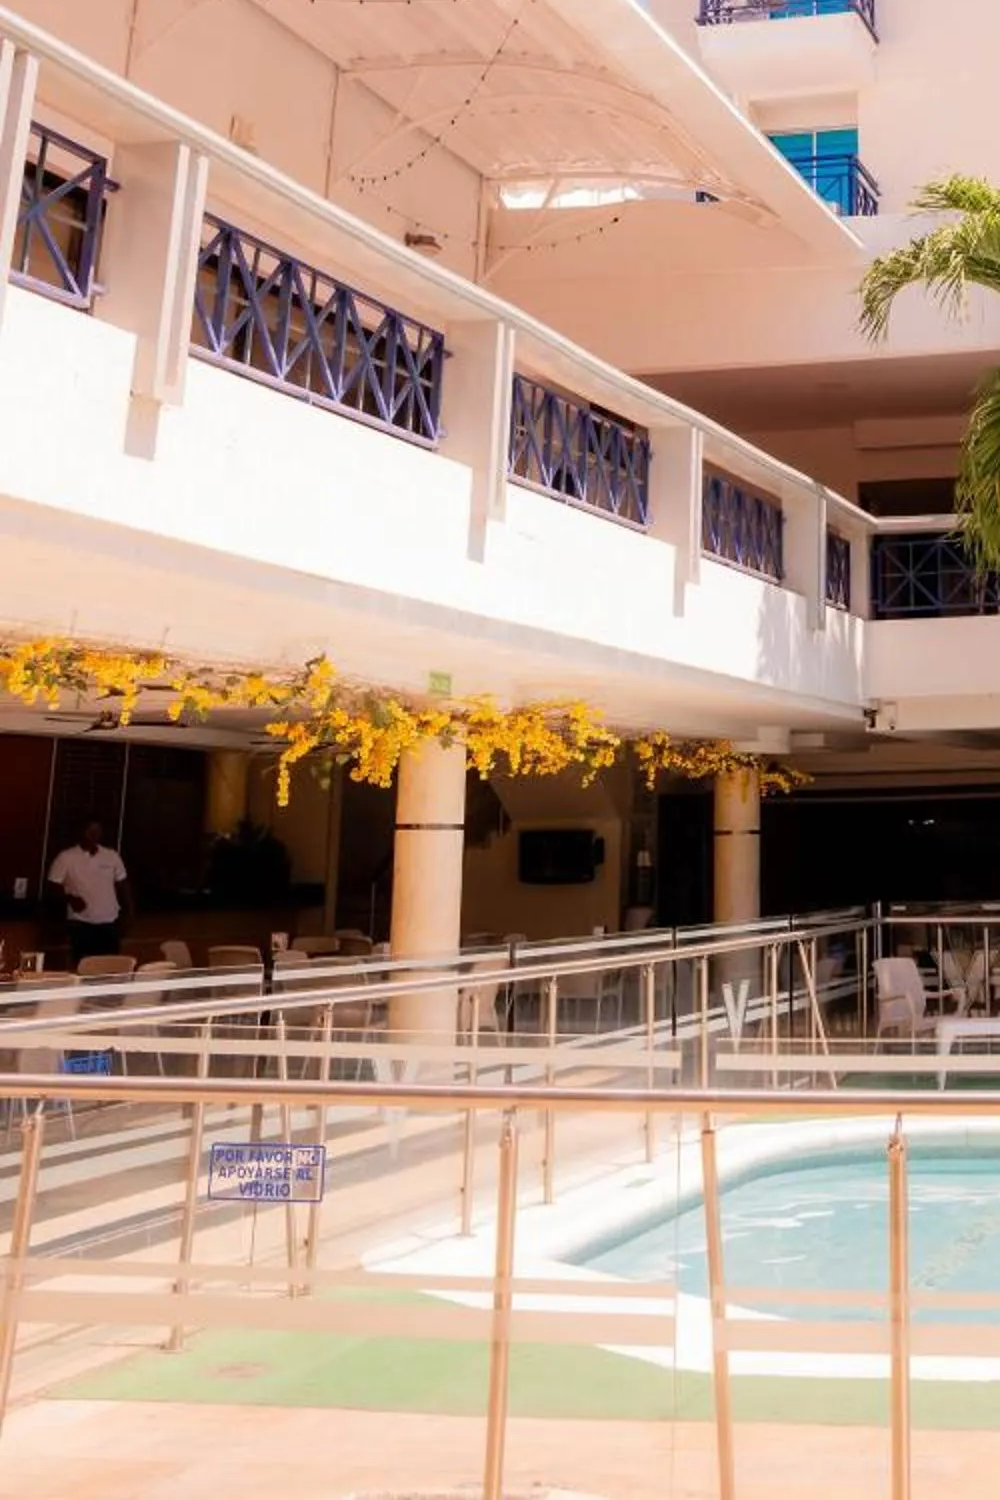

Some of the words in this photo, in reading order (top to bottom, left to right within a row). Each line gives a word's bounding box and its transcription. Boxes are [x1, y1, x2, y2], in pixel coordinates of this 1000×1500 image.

[215, 1148, 243, 1162] POR
[249, 1149, 293, 1164] FAVOR
[218, 1166, 291, 1180] APOYARSE
[295, 1168, 312, 1181] AL
[239, 1182, 291, 1197] VIDRIO
